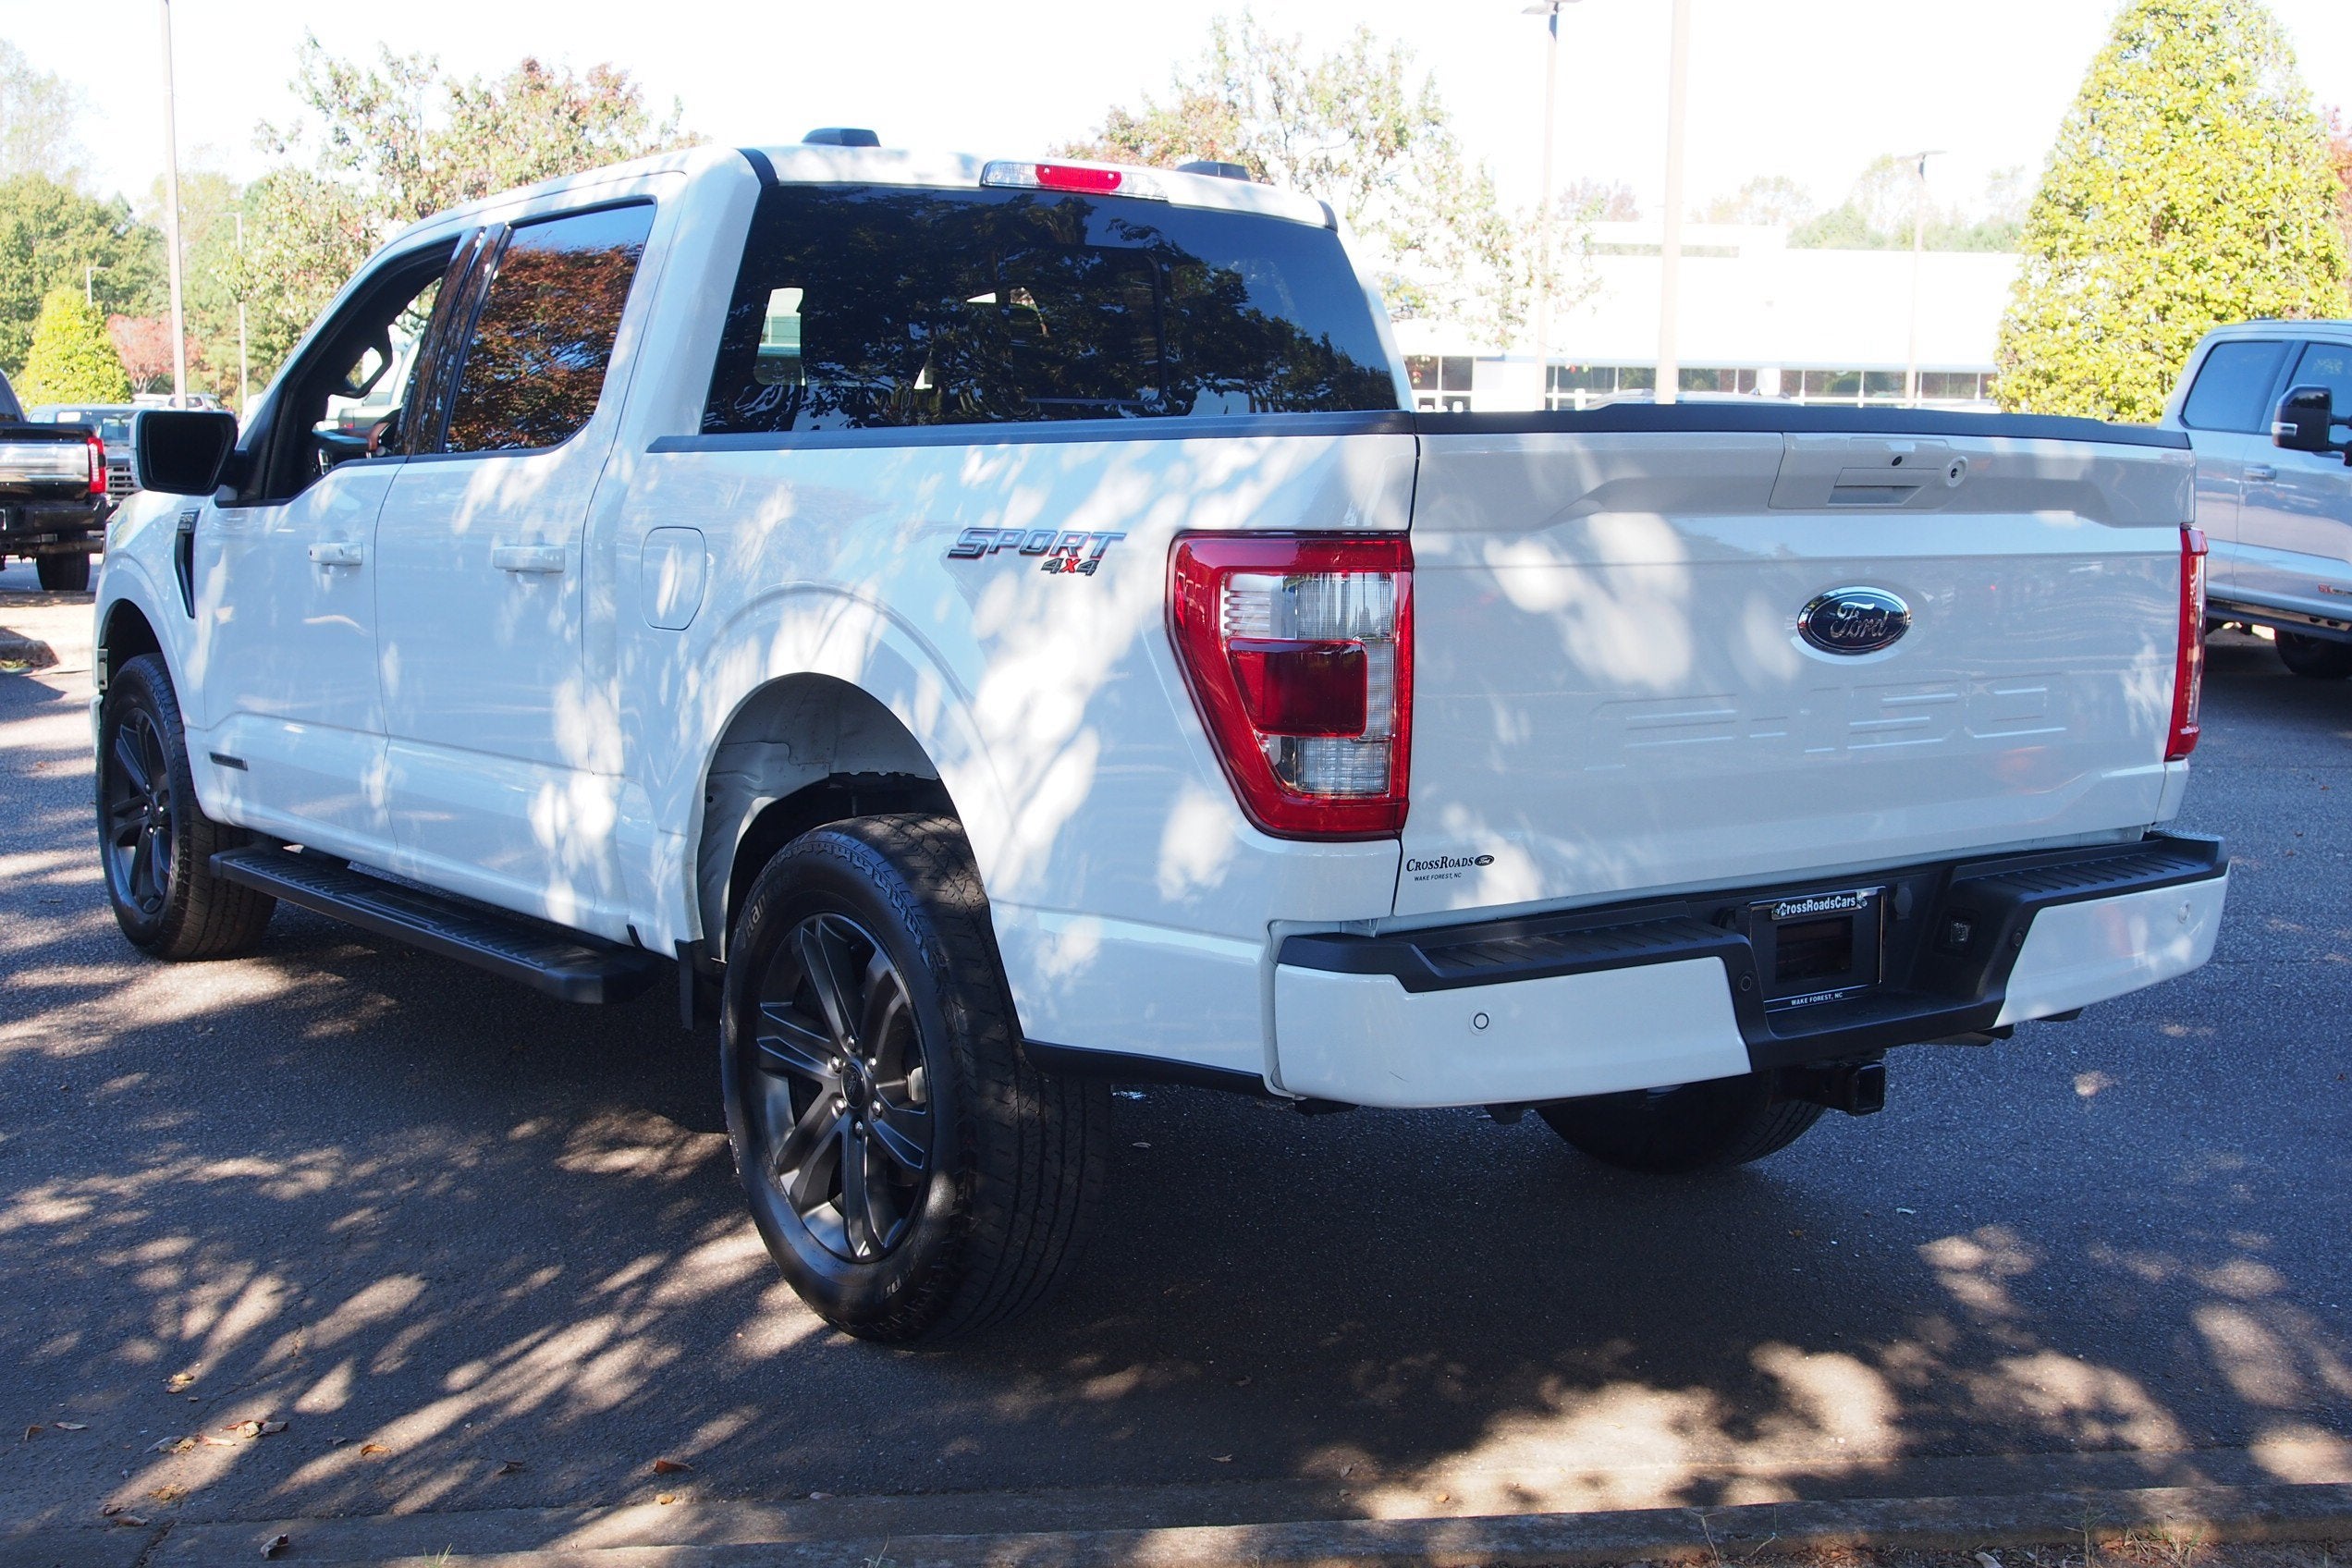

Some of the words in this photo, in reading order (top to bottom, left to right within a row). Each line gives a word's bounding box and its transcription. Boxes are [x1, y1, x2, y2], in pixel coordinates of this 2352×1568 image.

[948, 527, 1127, 559] SPORT
[1830, 601, 1890, 638] Ford
[1780, 895, 1856, 917] CrossRoadsCars
[1809, 994, 1834, 1003] FOREST,
